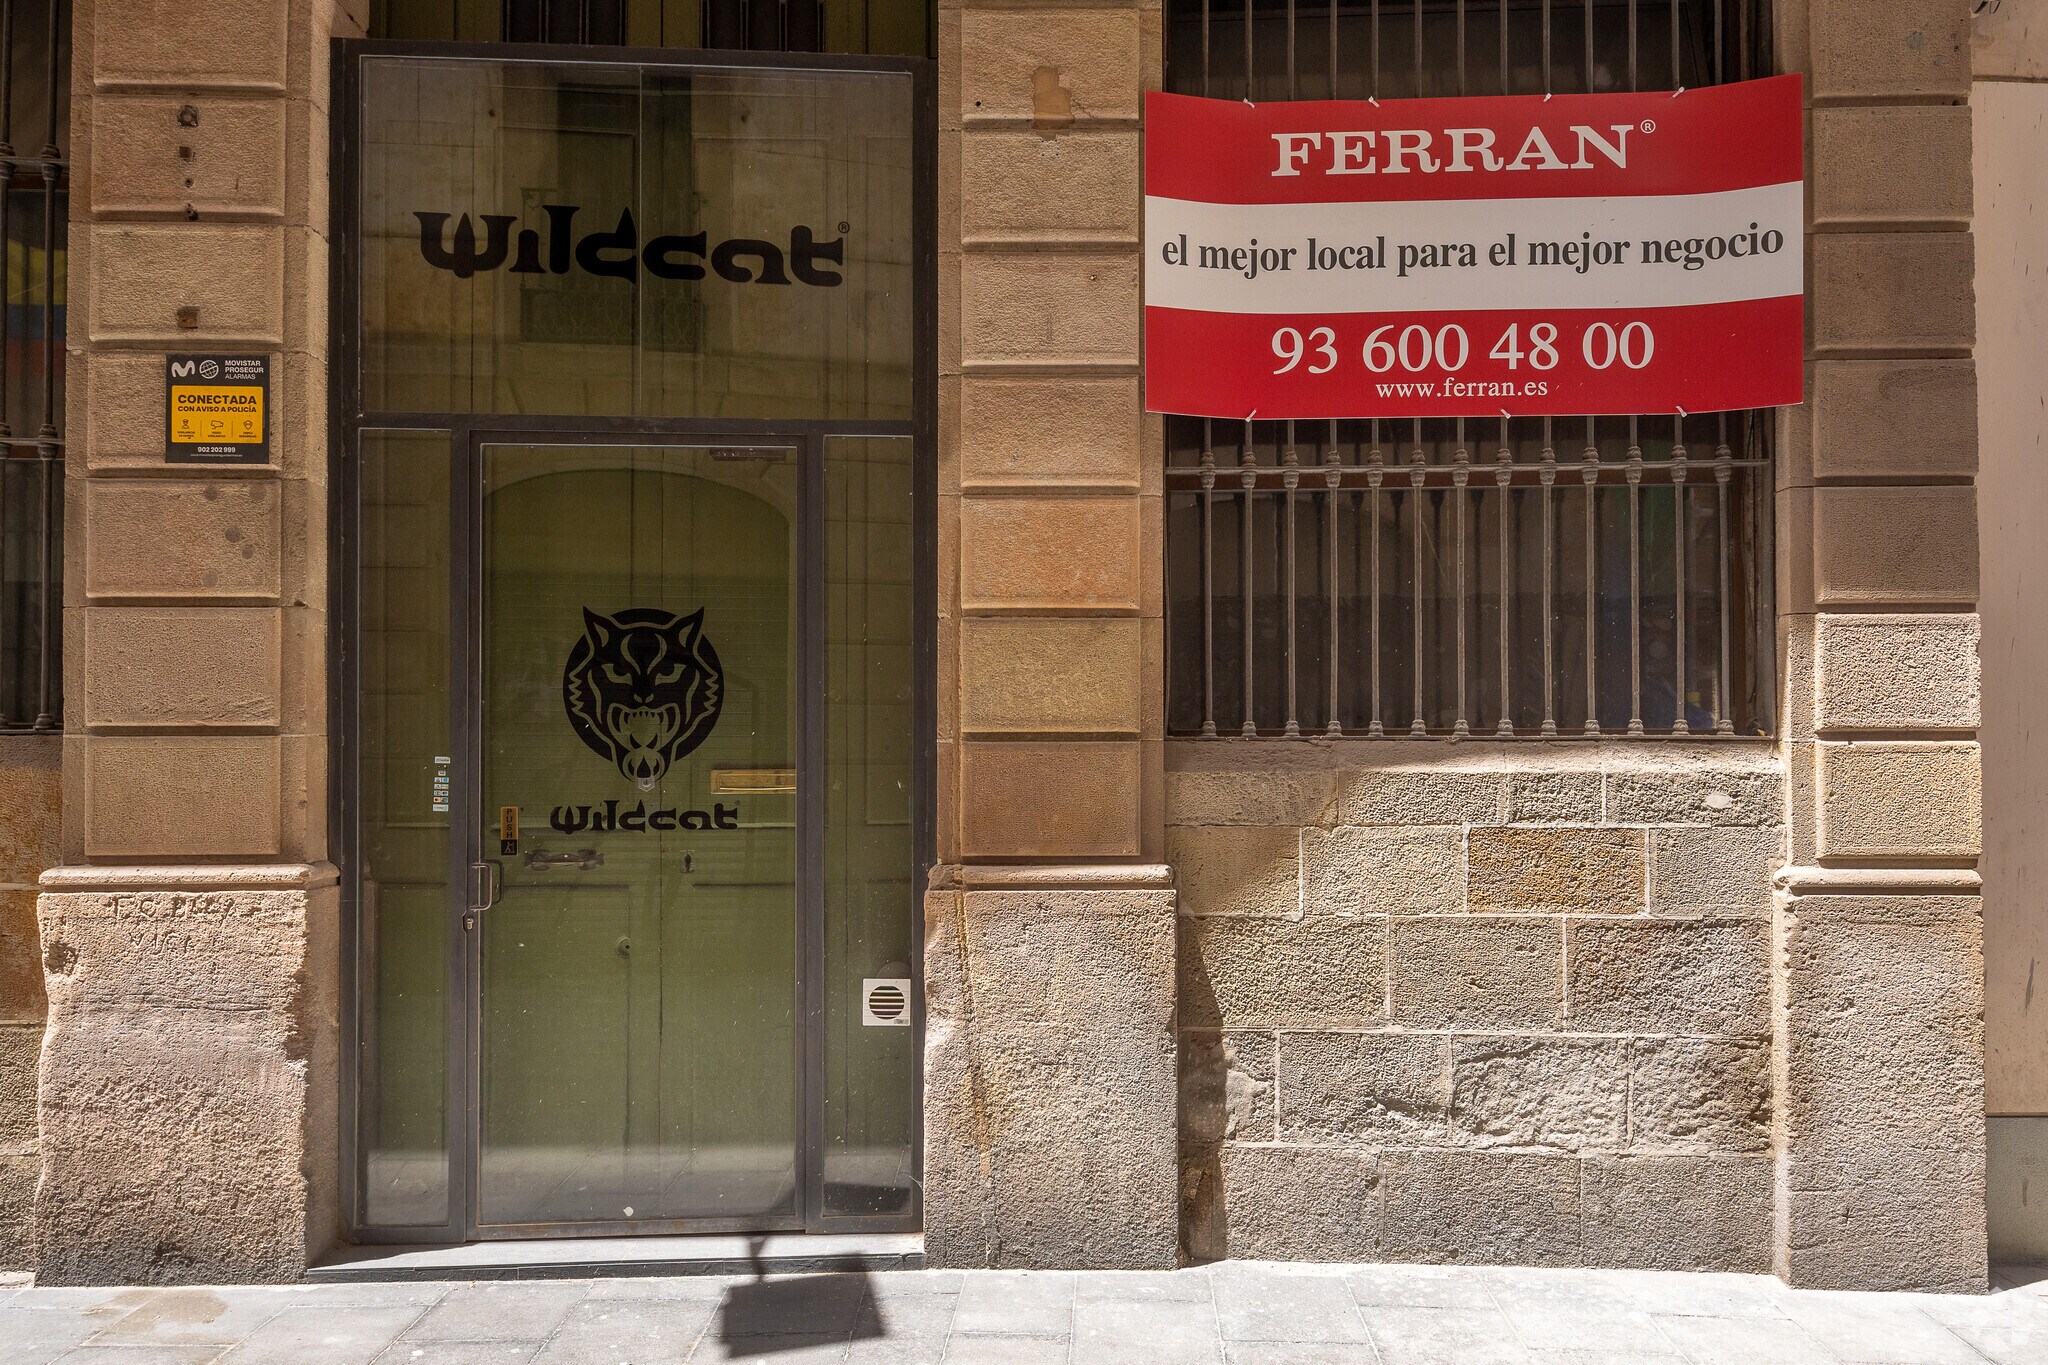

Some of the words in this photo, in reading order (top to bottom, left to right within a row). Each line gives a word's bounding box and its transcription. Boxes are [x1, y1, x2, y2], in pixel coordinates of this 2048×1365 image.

[1271, 124, 1634, 177] FERRAN
[1162, 234, 1187, 266] el
[1199, 238, 1297, 280] mejor
[1307, 236, 1386, 271] local
[1397, 242, 1478, 278] para
[1488, 233, 1516, 267] el
[1527, 231, 1630, 274] mejor
[1640, 221, 1784, 271] negocio
[1271, 326, 1338, 375] 93
[1362, 323, 1469, 373] 600
[1489, 322, 1559, 371] 48
[1582, 321, 1655, 370] 00
[178, 394, 257, 405] CONECTADA
[1375, 377, 1548, 398] www.ferran.es
[227, 405, 257, 413] POLICÍA
